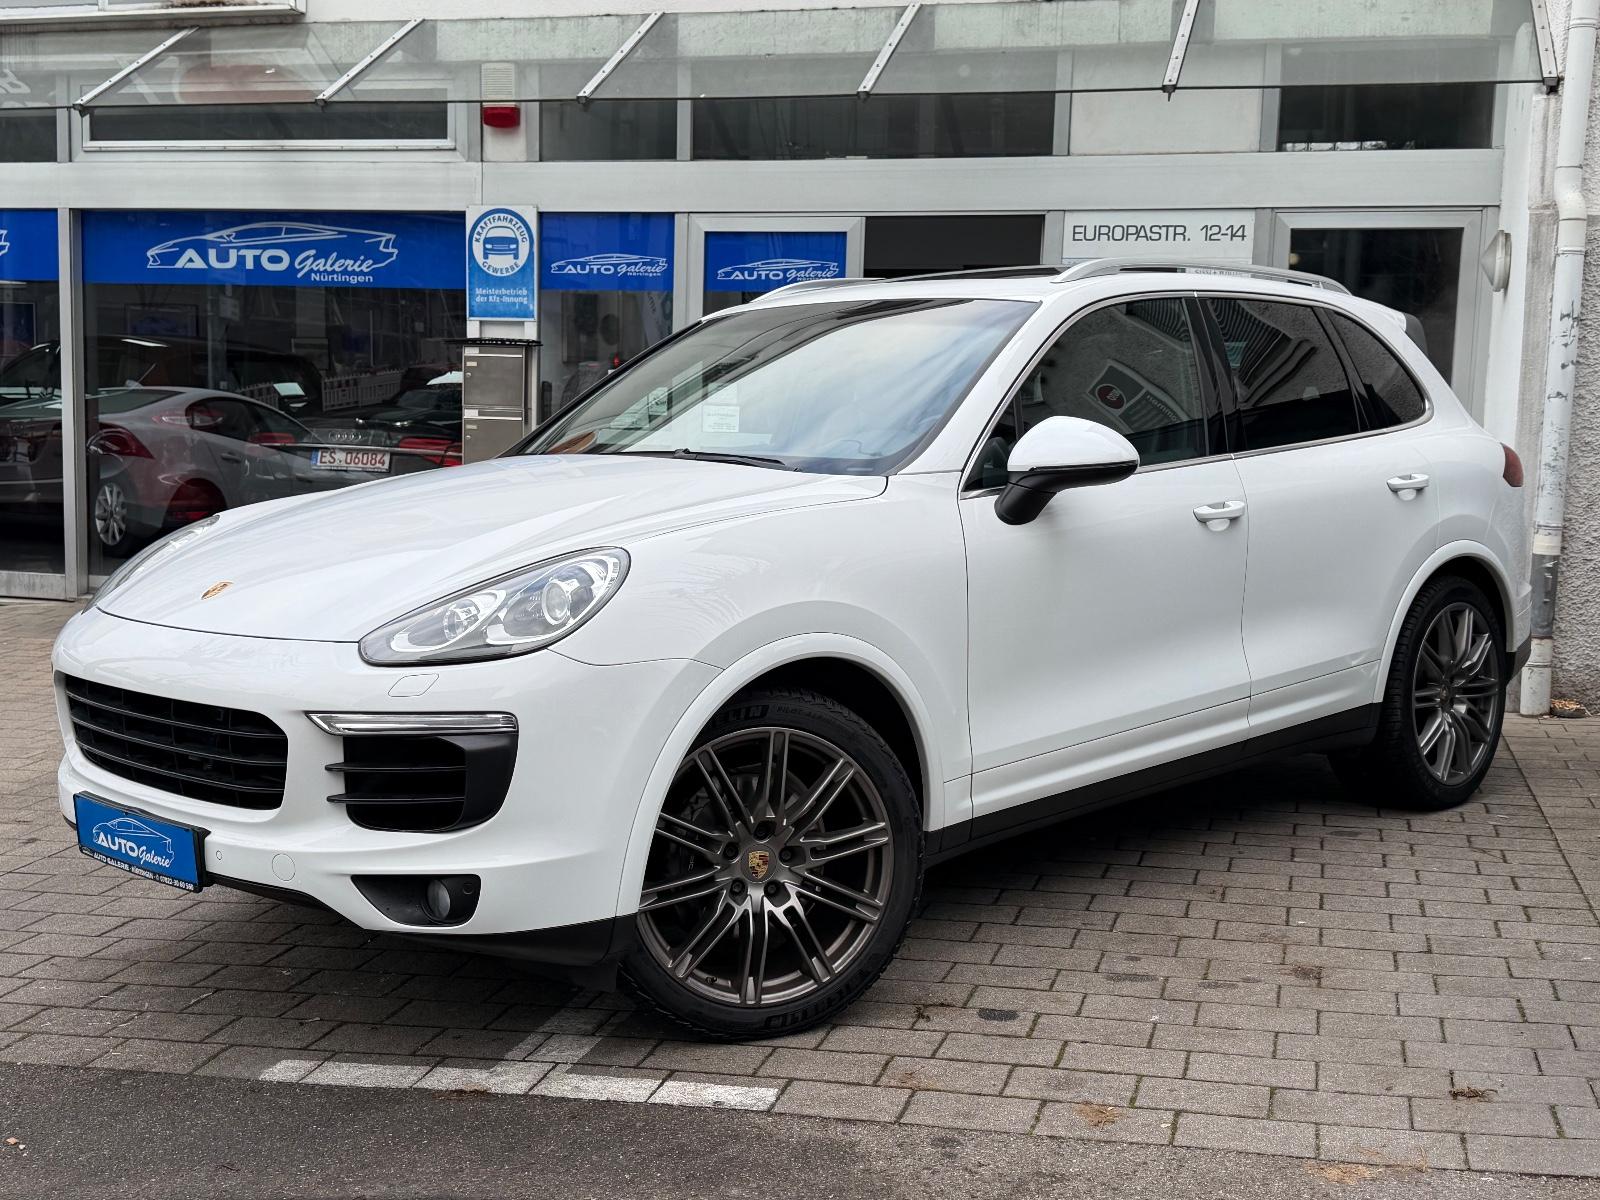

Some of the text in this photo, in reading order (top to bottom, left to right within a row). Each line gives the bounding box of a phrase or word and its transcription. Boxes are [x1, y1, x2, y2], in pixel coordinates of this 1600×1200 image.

[474, 215, 528, 243] KRAFTFAHRZEUG
[1072, 224, 1247, 242] EUROPASTR. 12-14
[174, 248, 375, 279] AUTO Galerie
[482, 260, 520, 275] GEWERBE
[563, 264, 615, 275] AUTO
[311, 272, 374, 284] Nürtingen
[730, 270, 784, 281] AUTO
[475, 287, 528, 296] Meisterbetrieb
[475, 295, 528, 304] der Kfz-Innung
[319, 448, 386, 467] ES 06084
[98, 831, 171, 868] AUTO Galerie
[94, 851, 107, 863] AUTO
[107, 857, 130, 871] GALERIE
